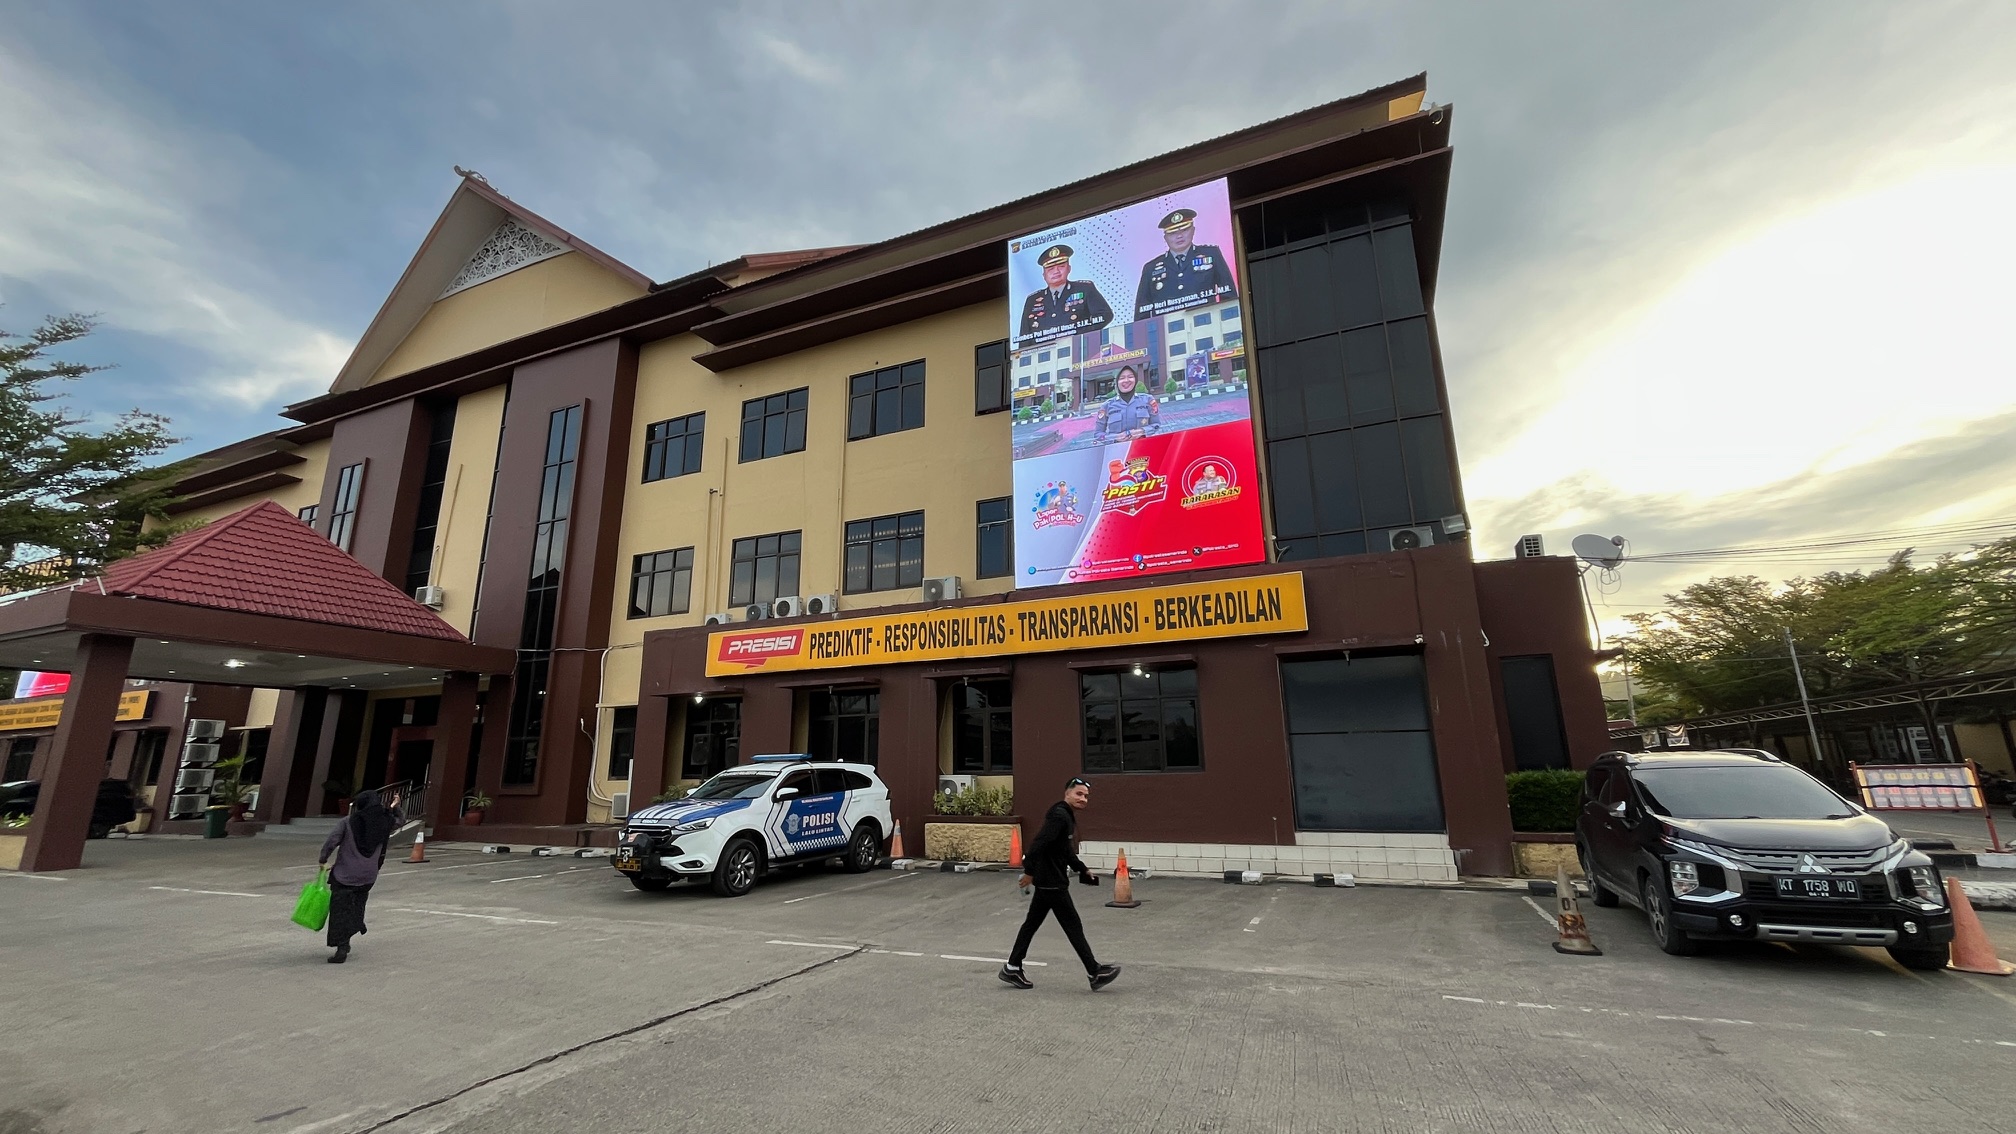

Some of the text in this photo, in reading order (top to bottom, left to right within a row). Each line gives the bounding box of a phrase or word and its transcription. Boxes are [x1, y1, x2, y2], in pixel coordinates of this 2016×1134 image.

[1072, 350, 1145, 370] PORESTA SAMARINDA
[1050, 513, 1065, 522] POL
[809, 627, 874, 660] PREDIKTIF
[884, 614, 1006, 653] RESPONSIBILITAS
[1018, 601, 1139, 642] TRANSPARANSI
[1154, 587, 1282, 631] BERKEADILAN
[728, 635, 797, 655] PRESISI
[802, 812, 835, 828] POLISI
[1779, 878, 1793, 891] KT
[1803, 879, 1829, 892] 1758
